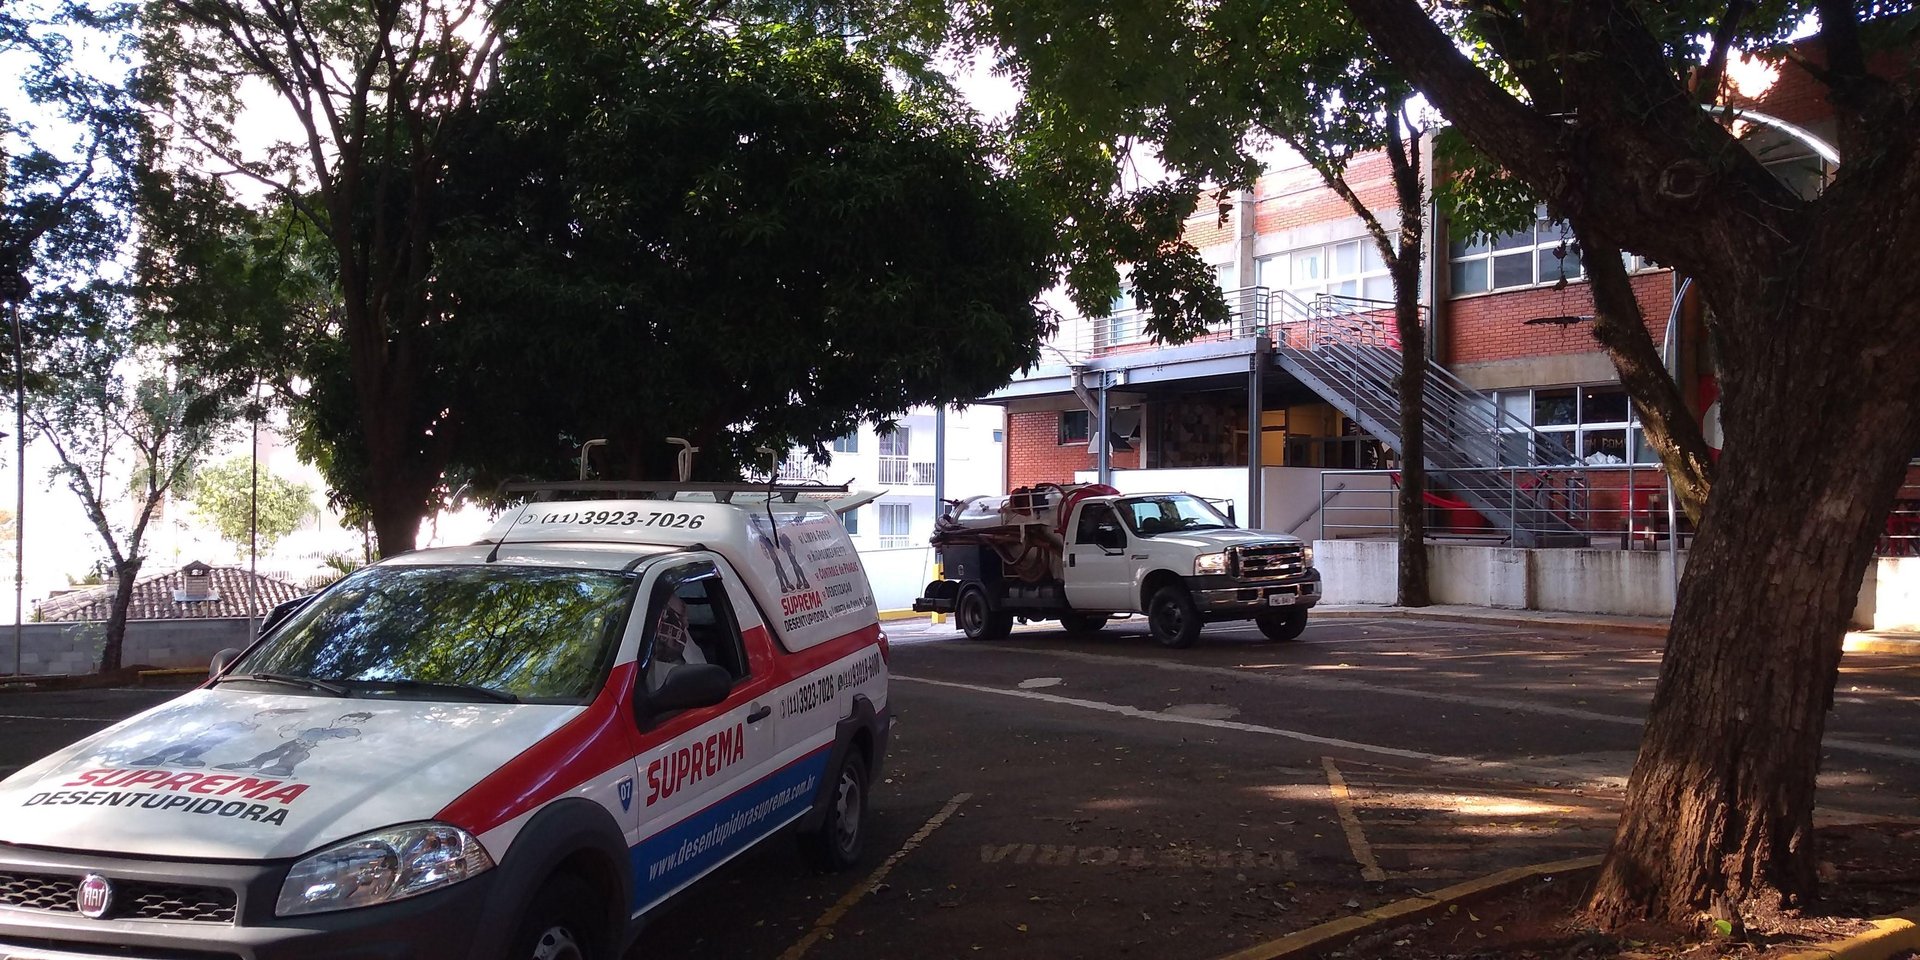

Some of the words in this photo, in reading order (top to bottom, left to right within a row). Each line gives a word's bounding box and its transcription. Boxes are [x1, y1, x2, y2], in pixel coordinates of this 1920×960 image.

[781, 591, 822, 616] SUPREMA
[784, 610, 830, 632] DESENTUPIDORA
[646, 722, 744, 807] SUPREMA
[63, 768, 310, 805] SUPREMA
[620, 781, 631, 801] 07
[21, 790, 291, 827] DESENTUPIDORA
[648, 773, 816, 882] www.desentupidorasuprema.com.br
[83, 885, 105, 907] FIAT
